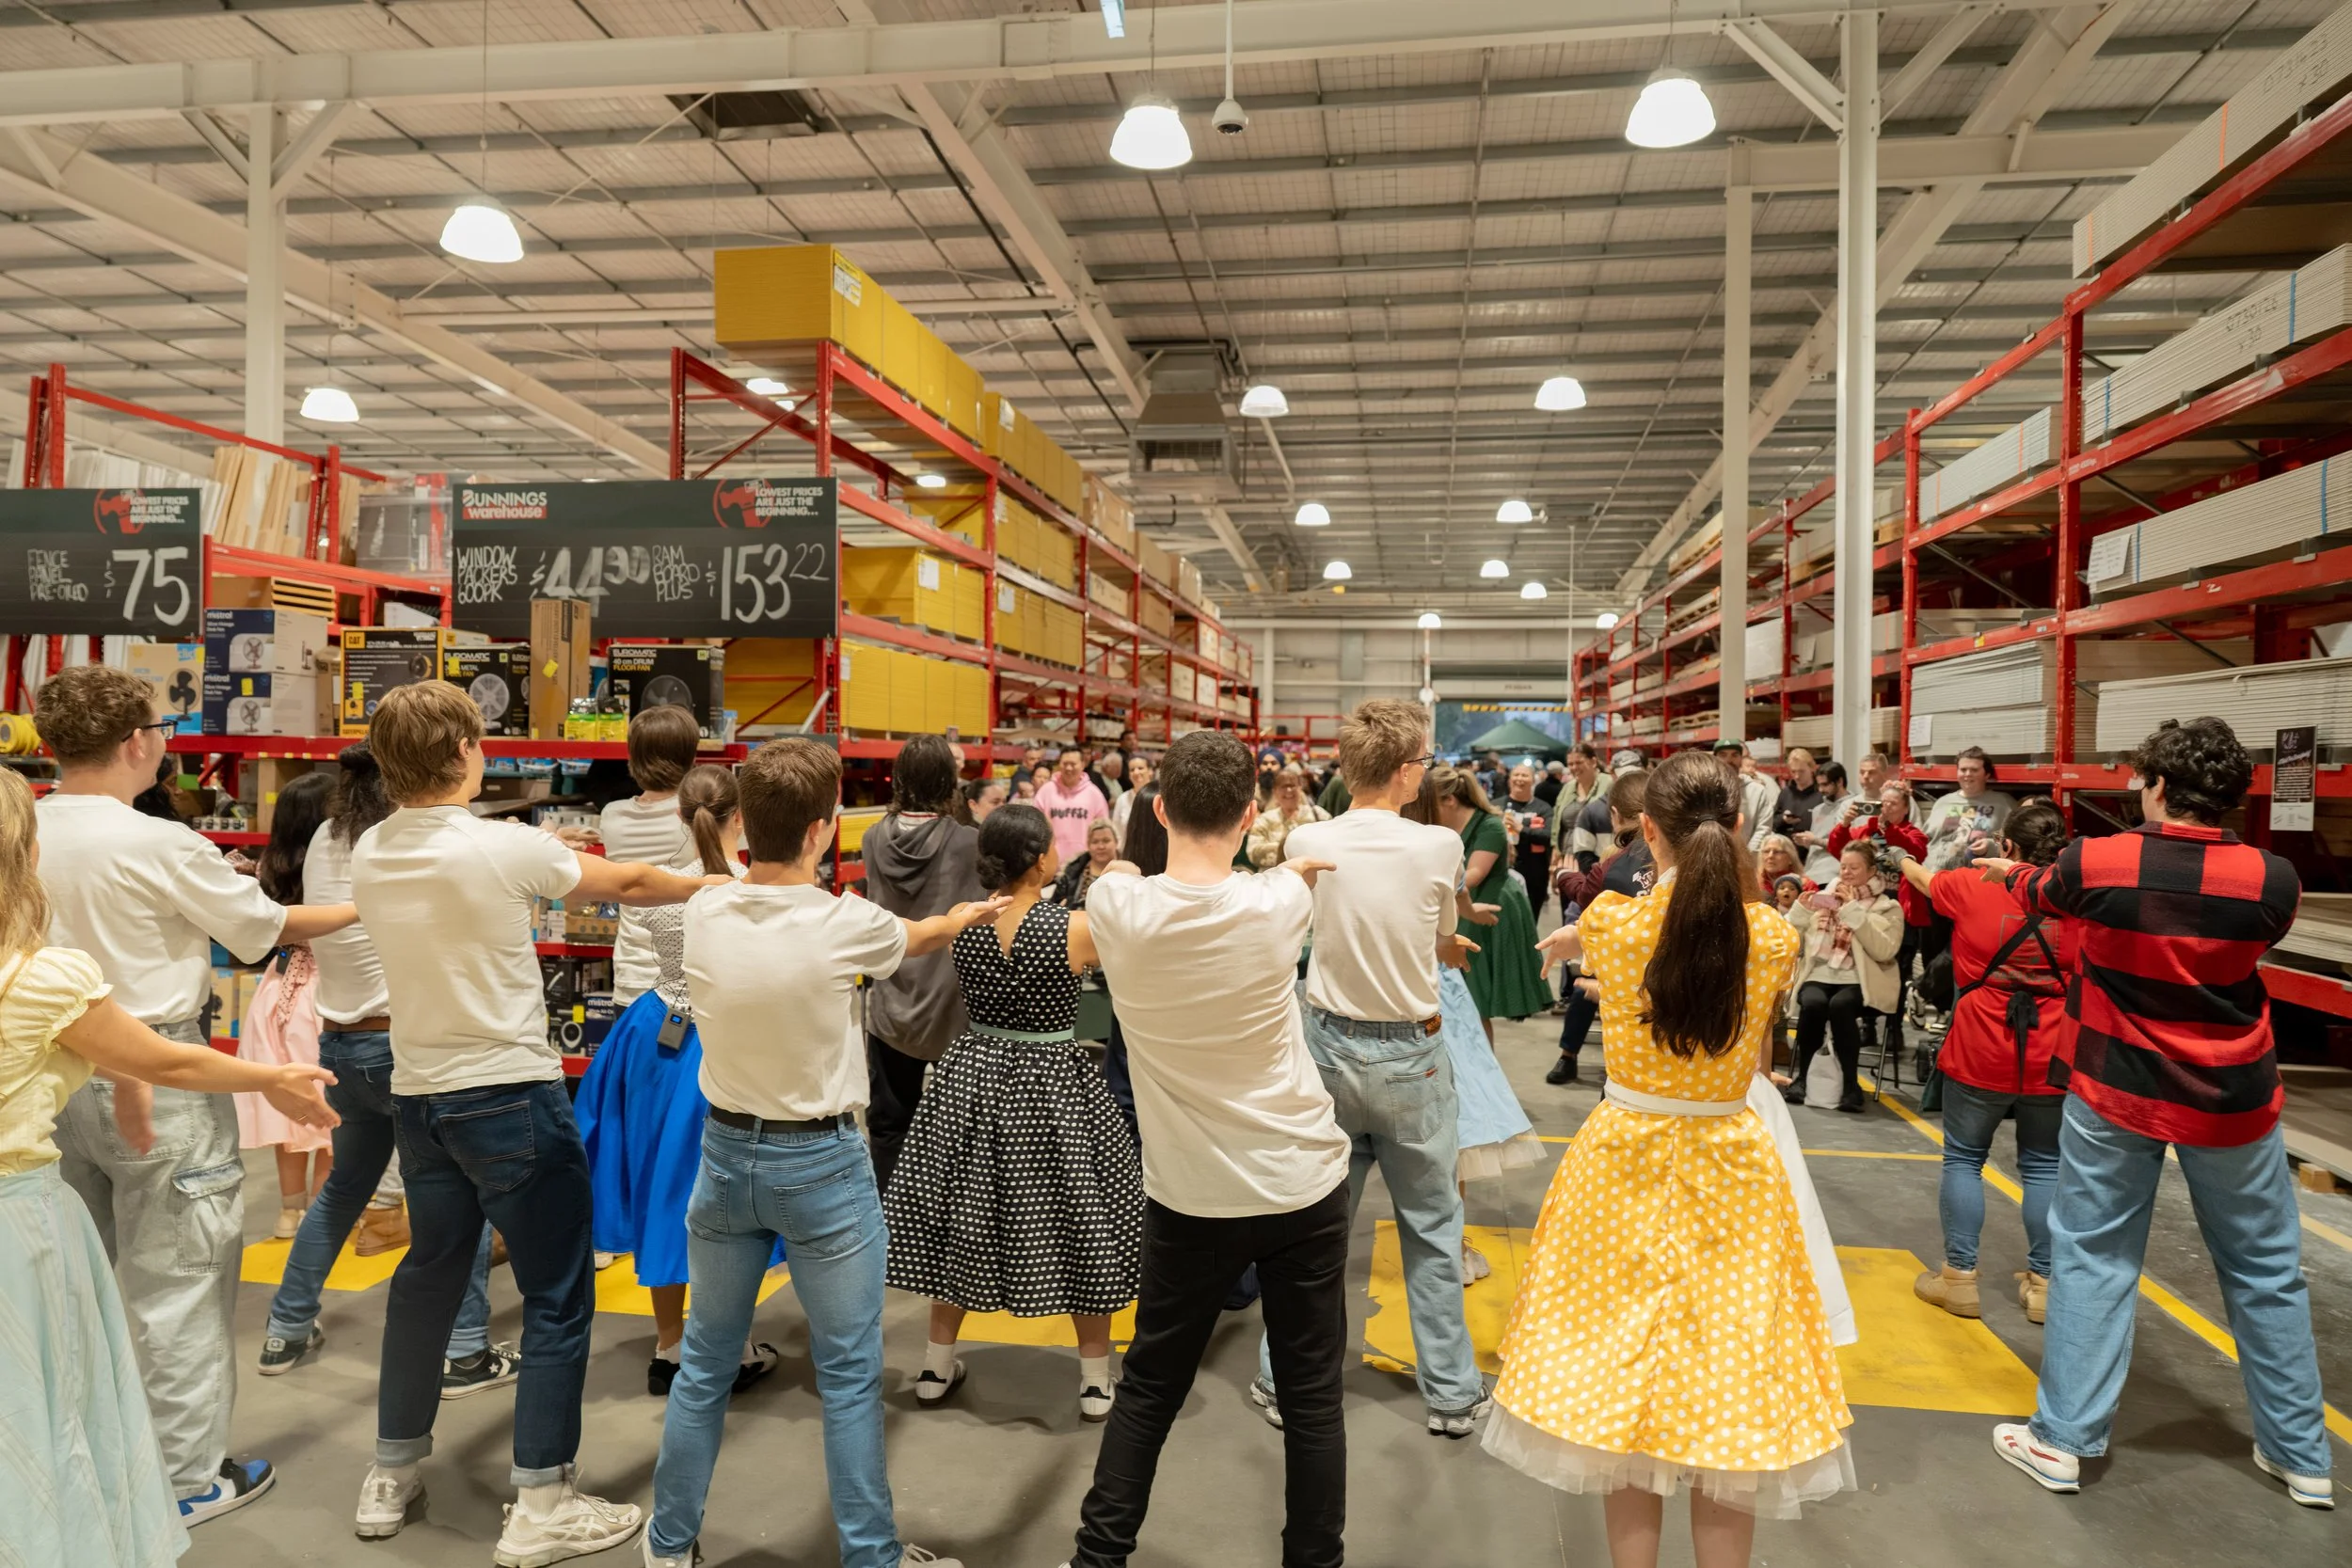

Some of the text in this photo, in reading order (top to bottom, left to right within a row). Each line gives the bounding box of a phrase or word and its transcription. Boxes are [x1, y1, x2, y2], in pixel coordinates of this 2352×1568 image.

[755, 486, 824, 497] LOWEST PRICES
[755, 497, 814, 506] ARE JUST THE
[467, 504, 543, 518] warehouse
[26, 548, 71, 568] FENCE
[456, 546, 517, 568] WINDOW
[652, 545, 686, 567] RAM
[458, 564, 518, 585] PACKERS
[652, 563, 701, 585] BOARD
[457, 582, 503, 604] 600PK
[656, 579, 693, 602] PLUS
[348, 636, 364, 644] CAT
[587, 997, 614, 1006] mistra
